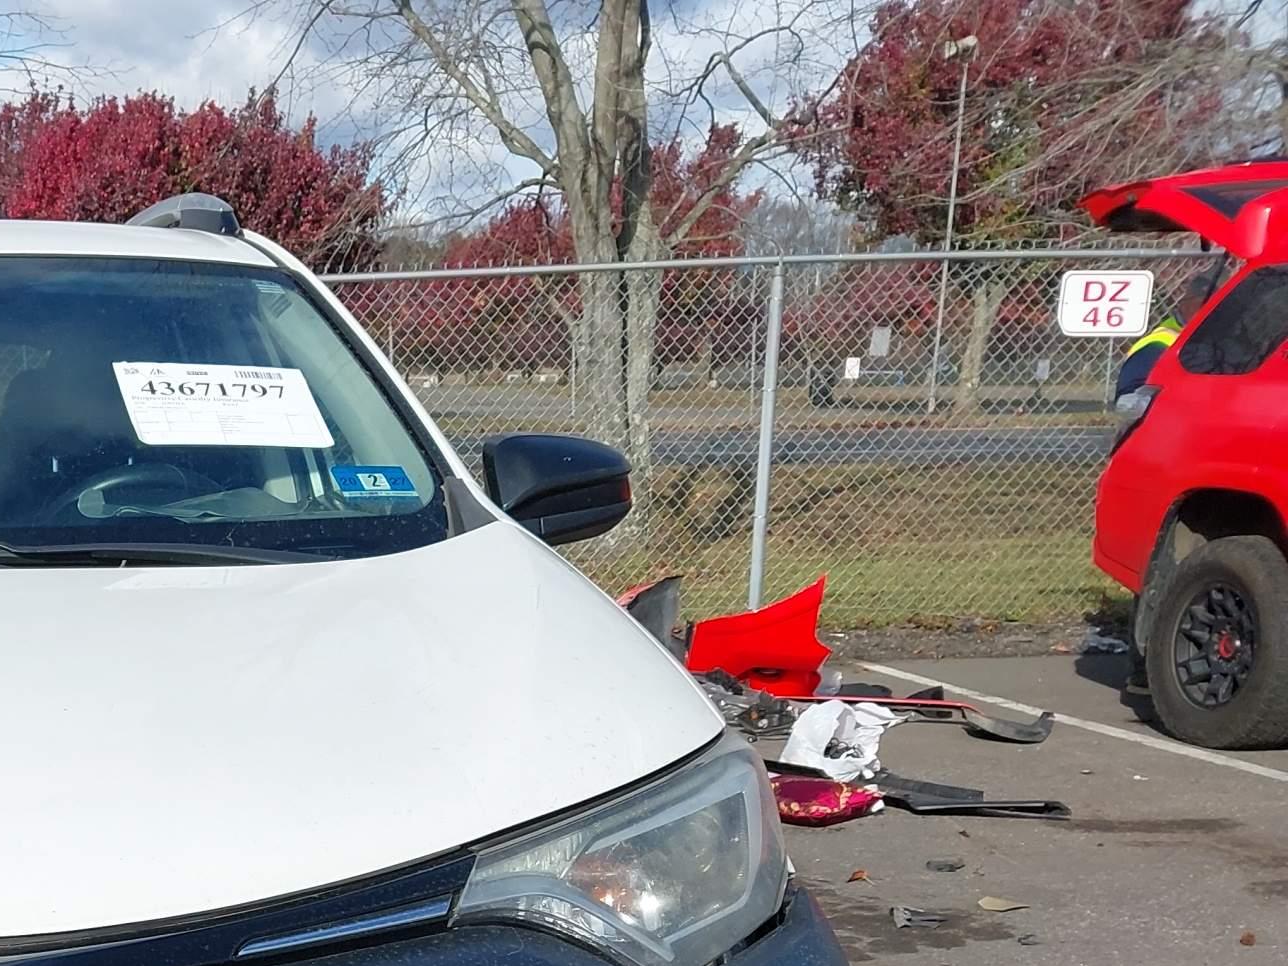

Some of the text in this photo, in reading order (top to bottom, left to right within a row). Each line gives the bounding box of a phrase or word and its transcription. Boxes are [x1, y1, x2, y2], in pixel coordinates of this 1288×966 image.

[1082, 281, 1132, 303] DZ
[1082, 306, 1125, 328] 46
[140, 379, 285, 400] 43671797
[340, 477, 357, 486] 20
[367, 474, 382, 488] 2
